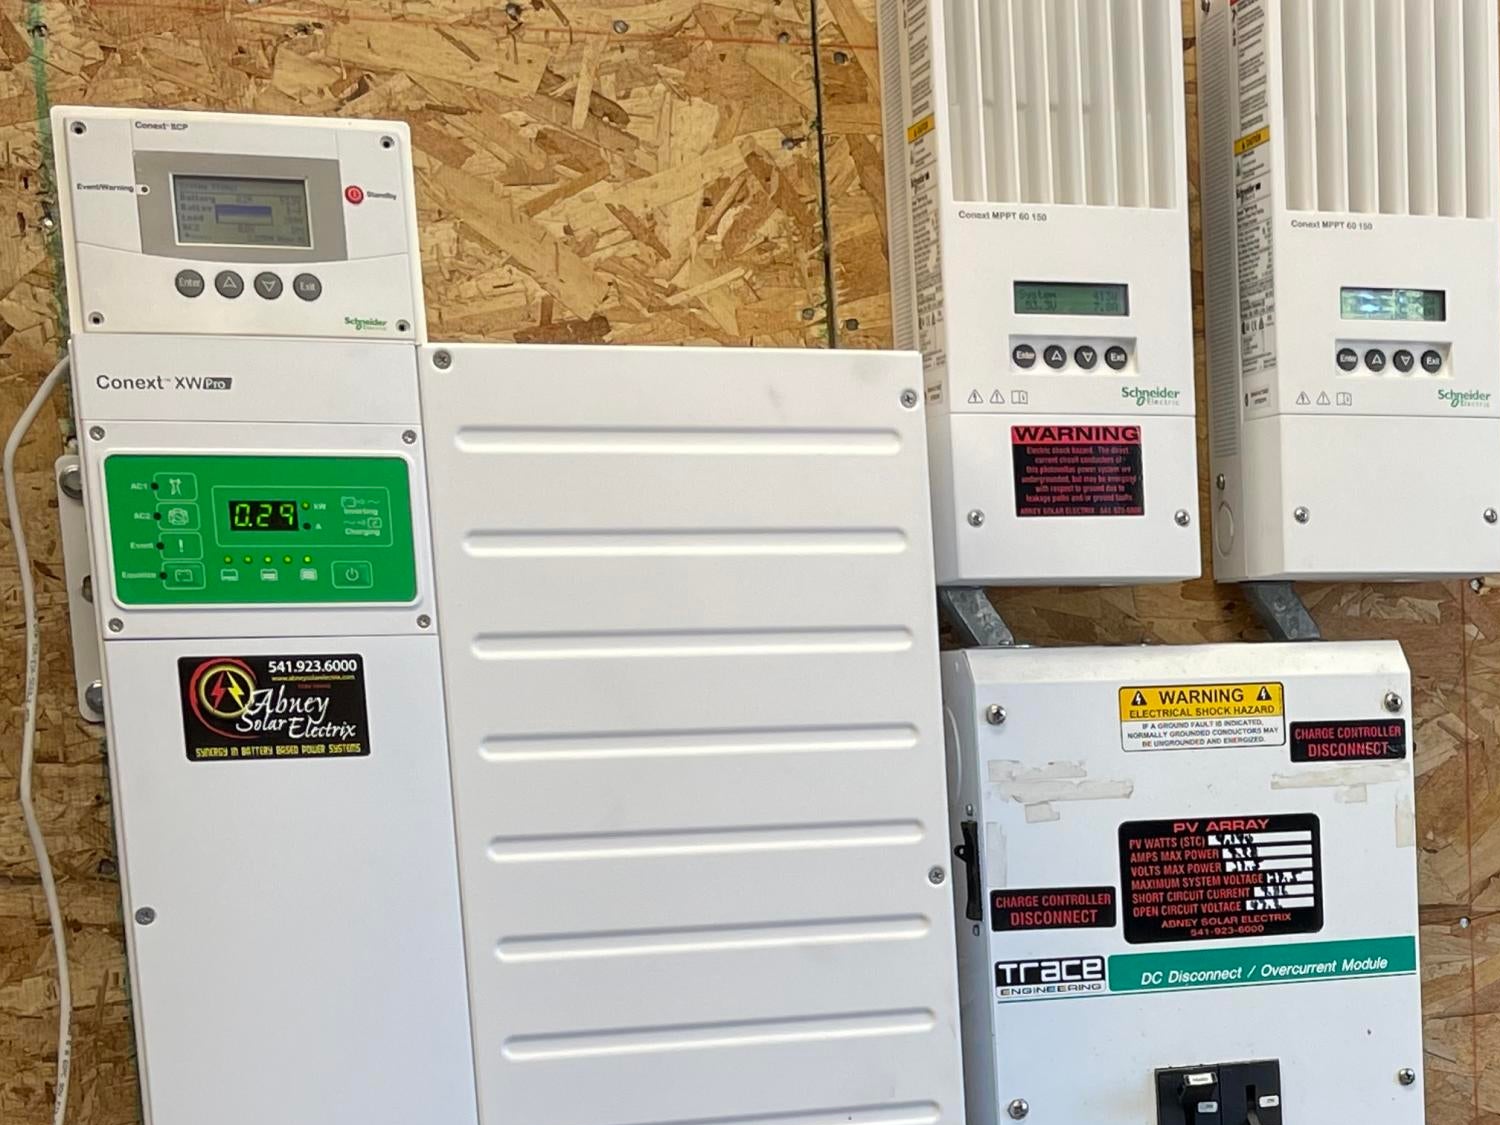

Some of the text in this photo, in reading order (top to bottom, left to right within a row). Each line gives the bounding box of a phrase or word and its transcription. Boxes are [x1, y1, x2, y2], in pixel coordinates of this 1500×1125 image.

[992, 211, 1016, 220] MPPT
[1019, 212, 1029, 221] 60
[1291, 219, 1320, 229] Conext
[1322, 221, 1344, 230] MPPT
[344, 317, 387, 331] Schneider
[1016, 350, 1035, 359] Enter
[1110, 352, 1125, 362] Exit
[1340, 354, 1356, 363] Enter
[1426, 356, 1440, 365] Exit
[1121, 386, 1181, 402] Schneider
[1437, 389, 1491, 403] Schneider
[1014, 426, 1139, 441] WARNING
[234, 503, 294, 527] 0.29
[268, 659, 357, 673] 541.923.6000
[1159, 688, 1244, 705] WARNING
[245, 685, 329, 724] Abney
[1129, 705, 1275, 719] ELECTRICAL SHOCK HAZARD
[236, 713, 357, 741] Solar Electrix
[1127, 731, 1167, 739] NORMALLY
[1169, 730, 1210, 738] GROUNDED
[1212, 728, 1262, 736] CONDUCTORS
[1295, 725, 1401, 740] CHARGE CONTROLLER
[1154, 739, 1205, 747] UNGROUNDED
[1207, 737, 1221, 745] AND
[1308, 741, 1389, 757] DISCONNECT
[1173, 819, 1269, 833] PV ARRAY
[1129, 839, 1141, 849] PV
[1144, 837, 1177, 848] WATTS
[1180, 835, 1206, 848] (STC)
[1130, 852, 1158, 863] AMPS
[1161, 850, 1183, 862] MAX
[1185, 848, 1219, 860] POWER
[1131, 865, 1161, 877] VOLTS
[1164, 863, 1185, 875] MAX
[1187, 862, 1222, 874] POWER
[1131, 877, 1180, 890] MAXIMUM
[1182, 875, 1221, 888] SYSTEM
[1223, 873, 1264, 886] VOLTAGE
[996, 893, 1111, 909] CHARGE CONTROLLER
[1132, 892, 1164, 904] SHORT
[1167, 889, 1204, 902] CIRCUIT
[1206, 887, 1250, 900] CURRENT
[1133, 905, 1159, 918] OPEN
[1161, 903, 1199, 916] CIRCUIT
[1201, 900, 1242, 914] VOLTAGE
[1010, 909, 1098, 926] DISCONNECT
[1161, 913, 1292, 929] ABNEY SOLAR ELECTRIX
[1190, 924, 1265, 937] 541-923-6000
[1141, 956, 1389, 986] DC Disconnect / Overcurrent Module
[1000, 983, 1101, 996] ENGINEERING
